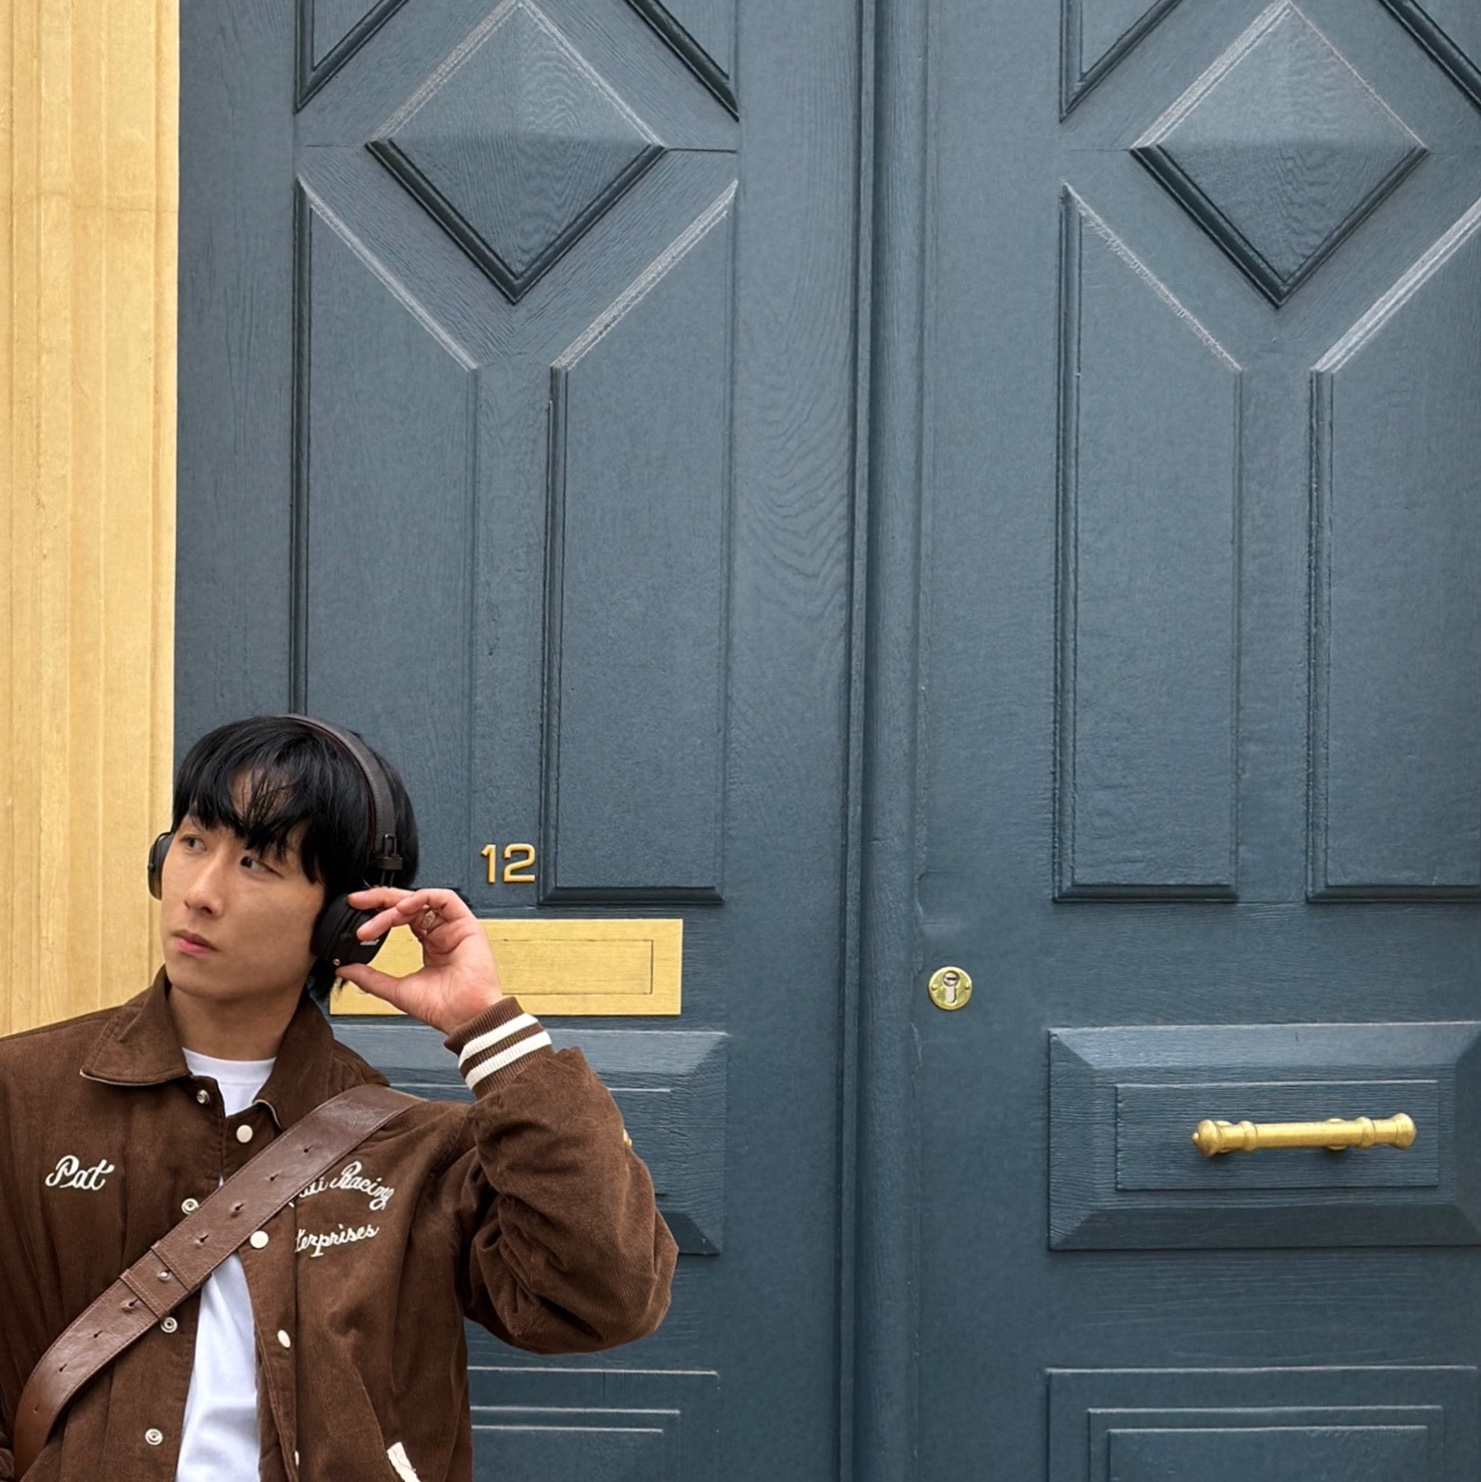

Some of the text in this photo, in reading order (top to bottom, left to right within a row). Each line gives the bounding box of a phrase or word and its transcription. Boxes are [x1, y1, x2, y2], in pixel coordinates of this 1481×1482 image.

[481, 843, 536, 884] 12
[45, 1154, 115, 1191] Pat
[329, 1160, 395, 1211] Racing
[295, 1223, 380, 1258] terprises
